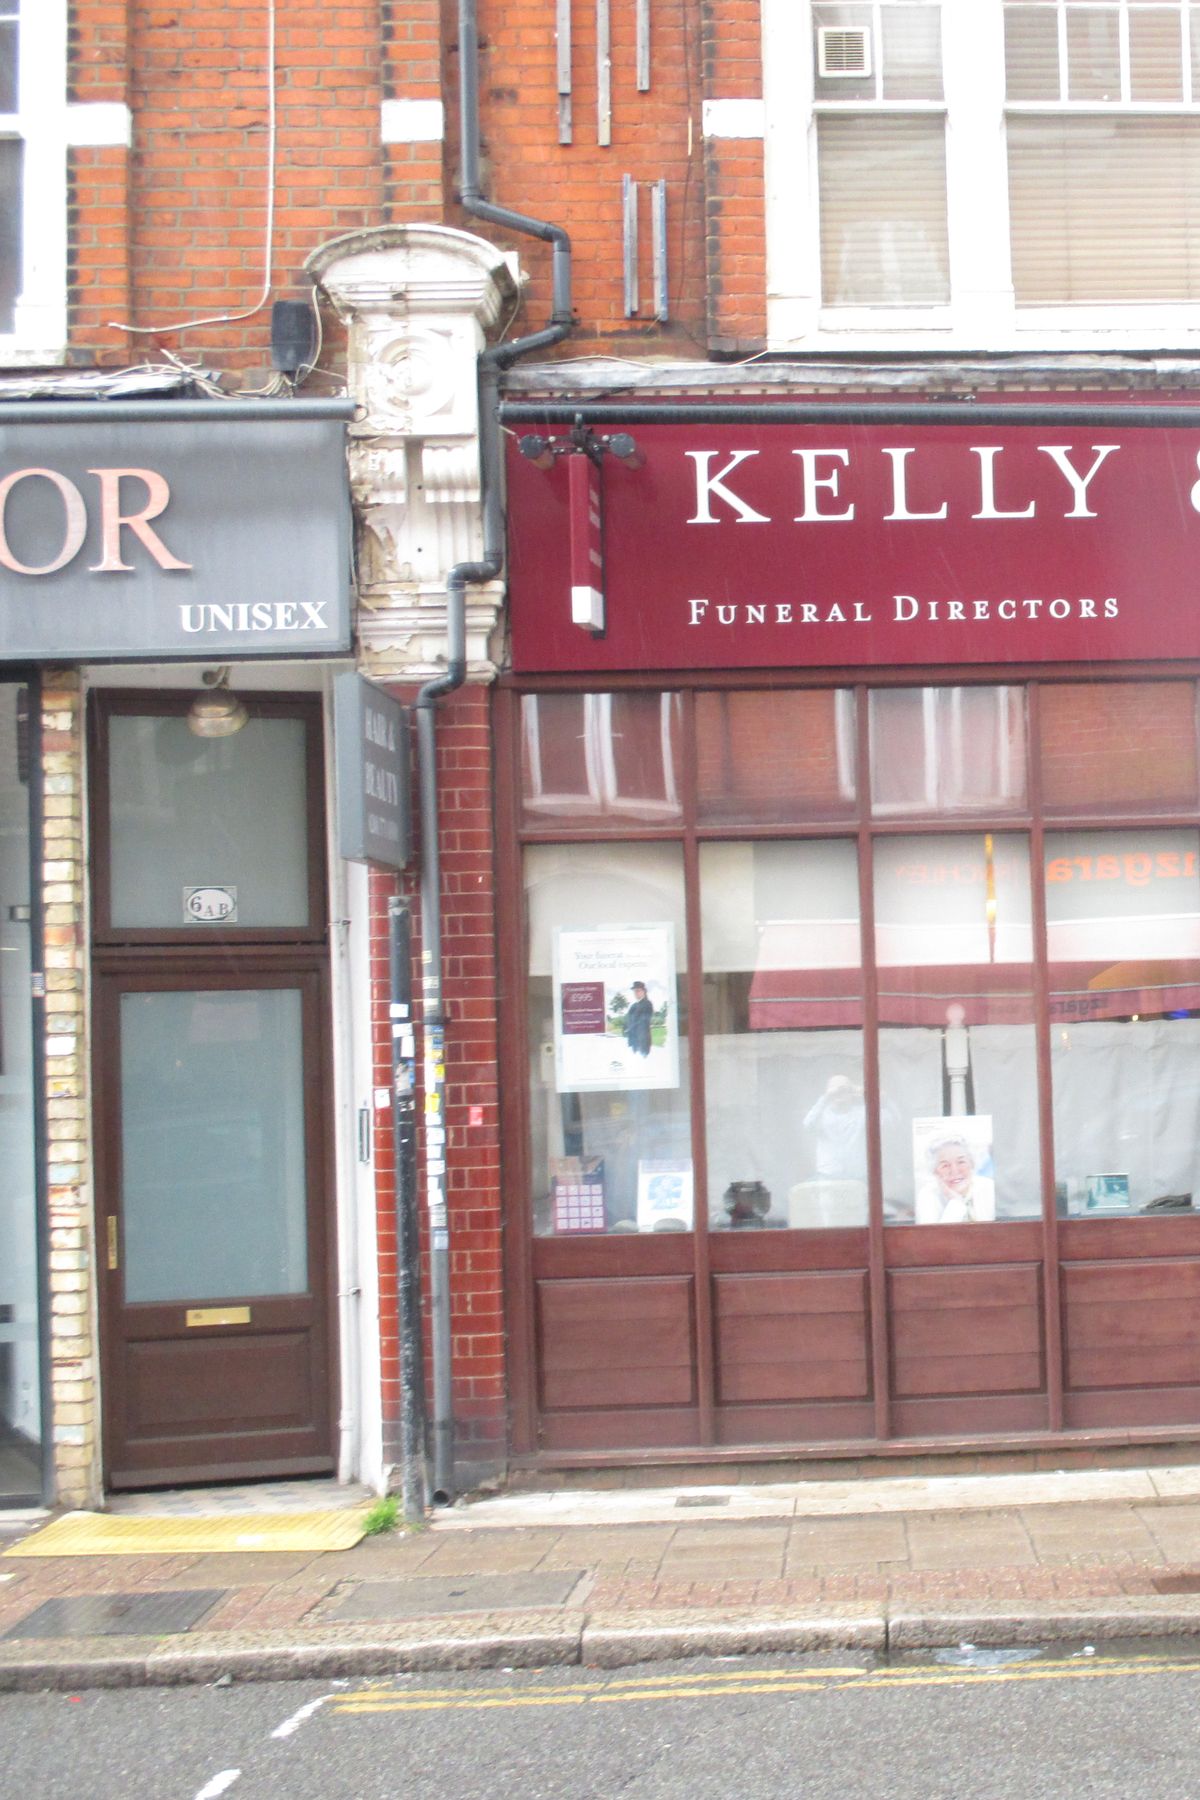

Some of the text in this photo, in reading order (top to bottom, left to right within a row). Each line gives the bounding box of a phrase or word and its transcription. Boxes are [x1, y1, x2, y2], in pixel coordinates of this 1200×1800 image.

[684, 445, 1121, 524] KELLY
[0, 468, 193, 575] OR
[179, 601, 328, 632] UNISEX
[687, 595, 1120, 624] FUNERAL DIRECTORS
